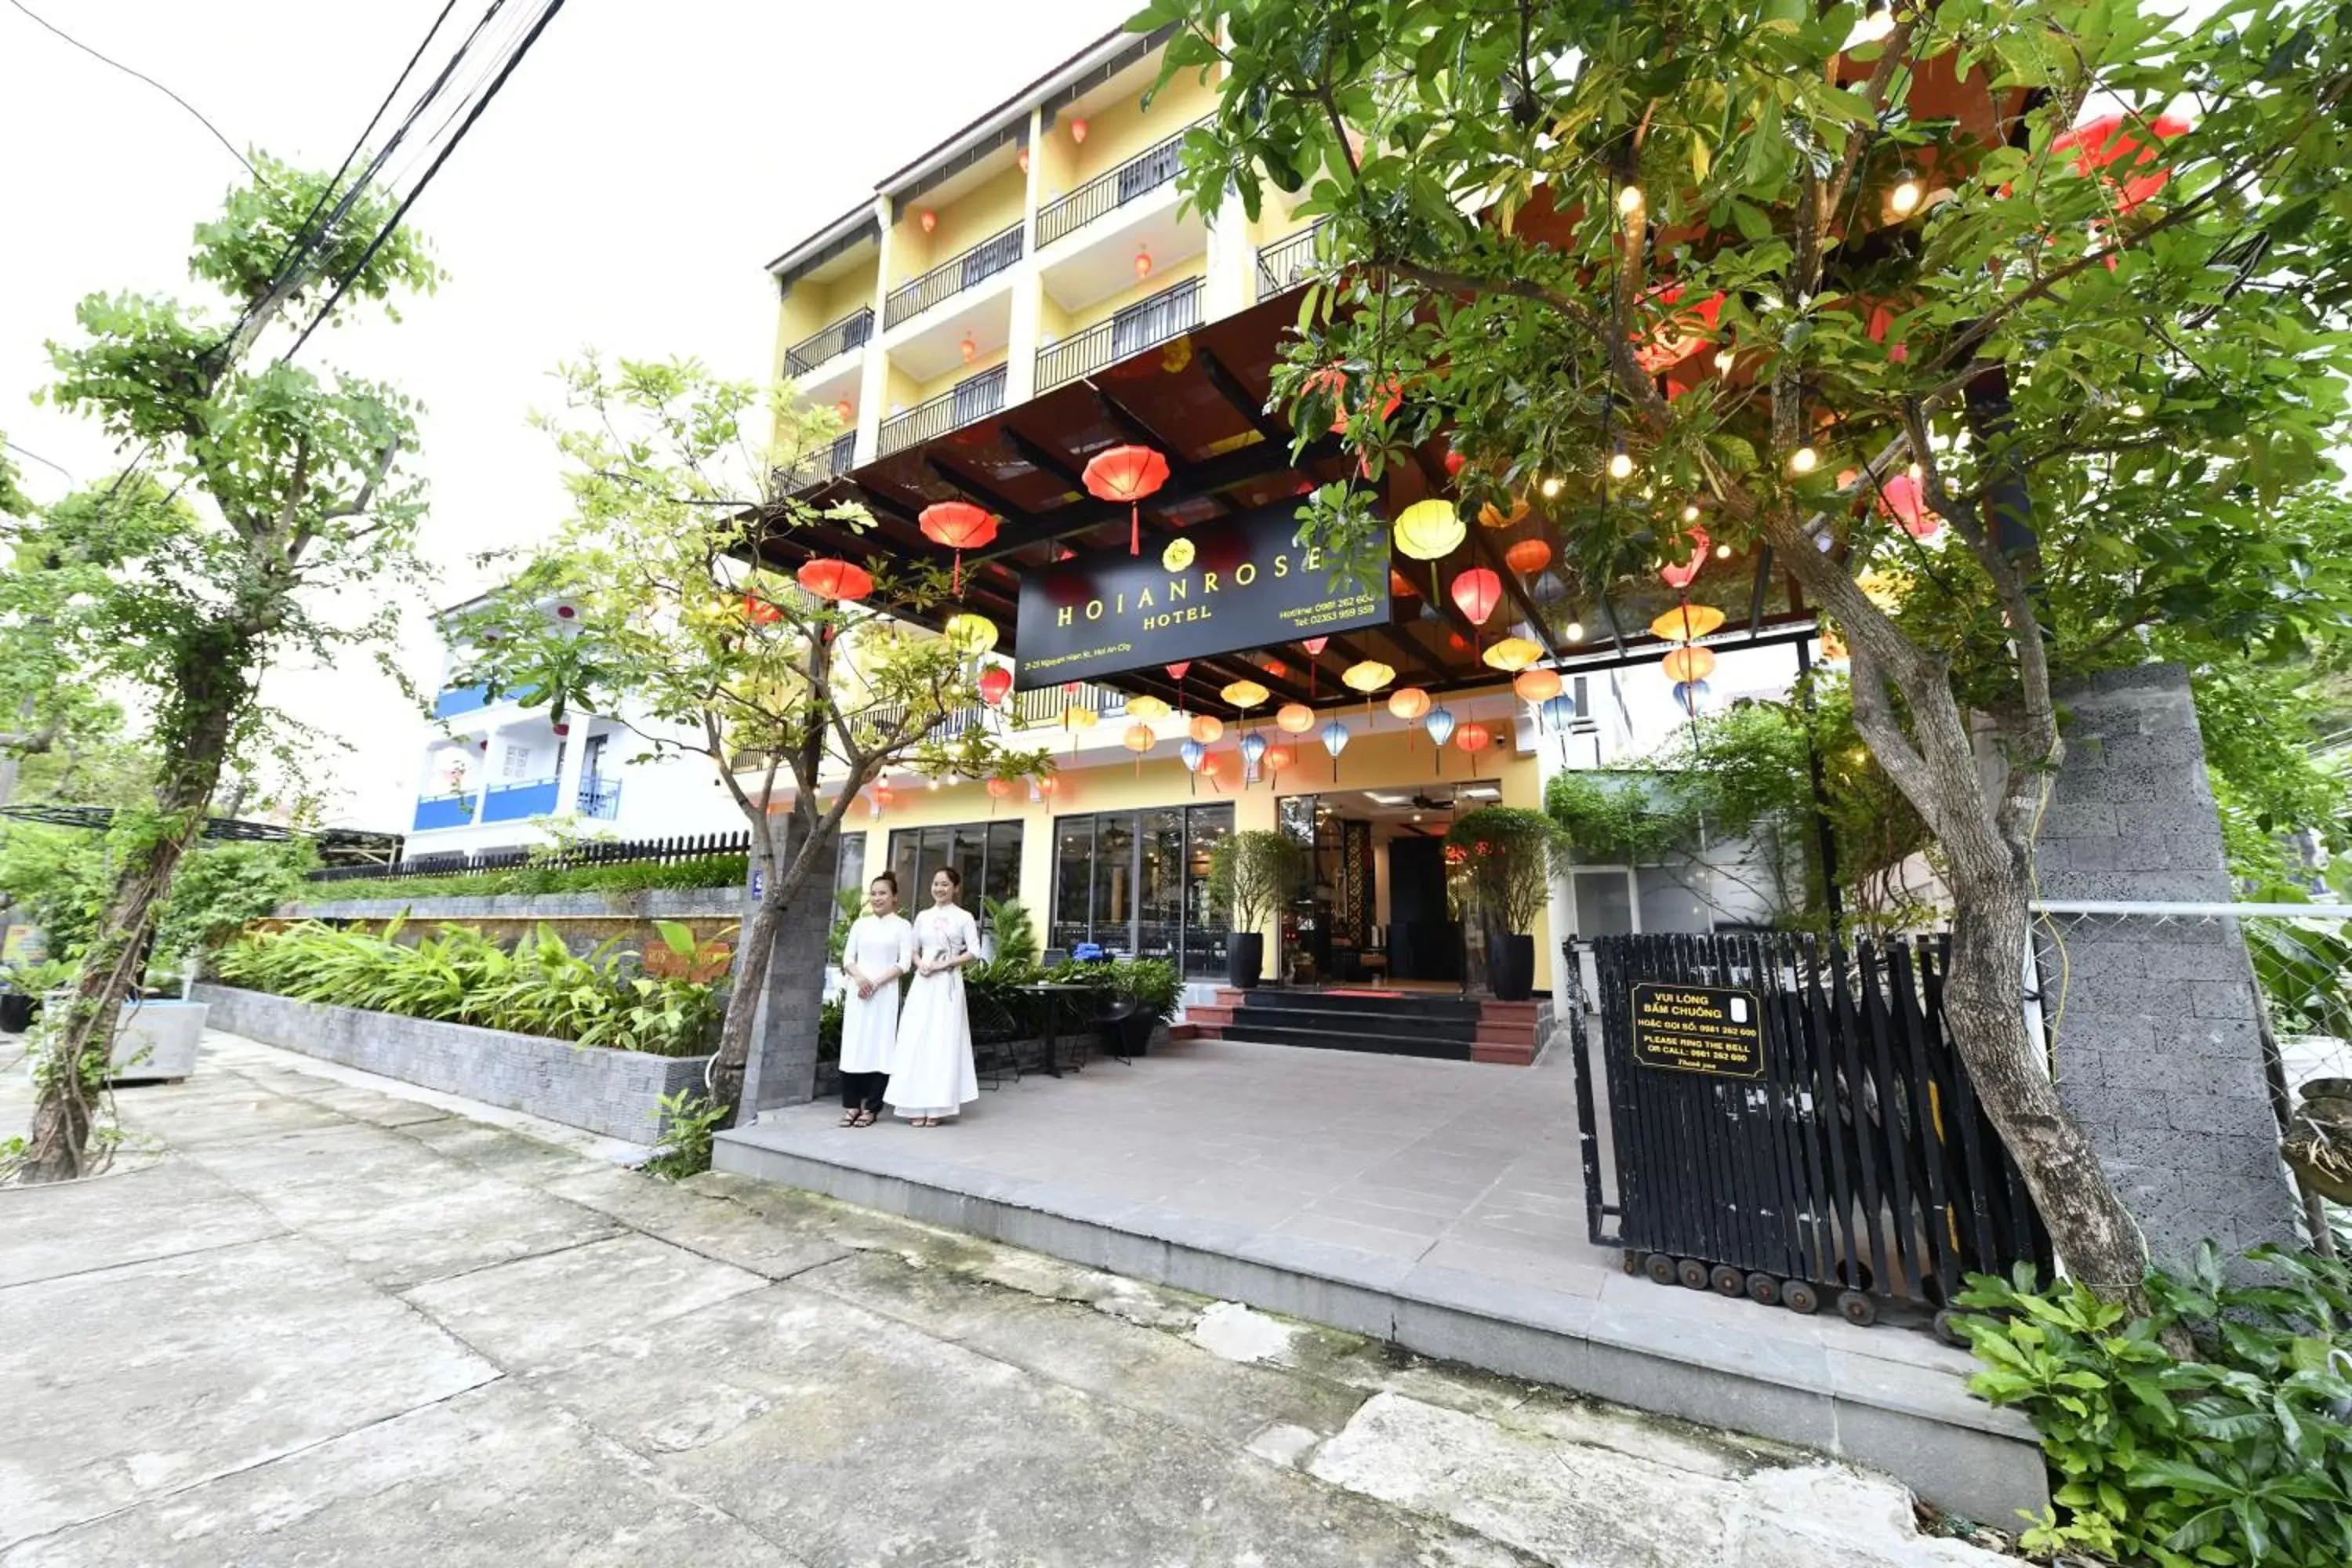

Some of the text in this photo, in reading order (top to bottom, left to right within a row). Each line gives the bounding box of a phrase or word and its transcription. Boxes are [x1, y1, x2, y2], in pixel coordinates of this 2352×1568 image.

[1144, 606, 1212, 630] HOTEL
[1655, 993, 1709, 1005] VUI LÒNG
[1671, 1006, 1722, 1018] CHUÔNG
[1643, 1035, 1751, 1053] PLEASE RING THE BELL
[1648, 1044, 1661, 1053] OR
[1663, 1047, 1688, 1056] CALL:
[1678, 1058, 1700, 1067] Thank
